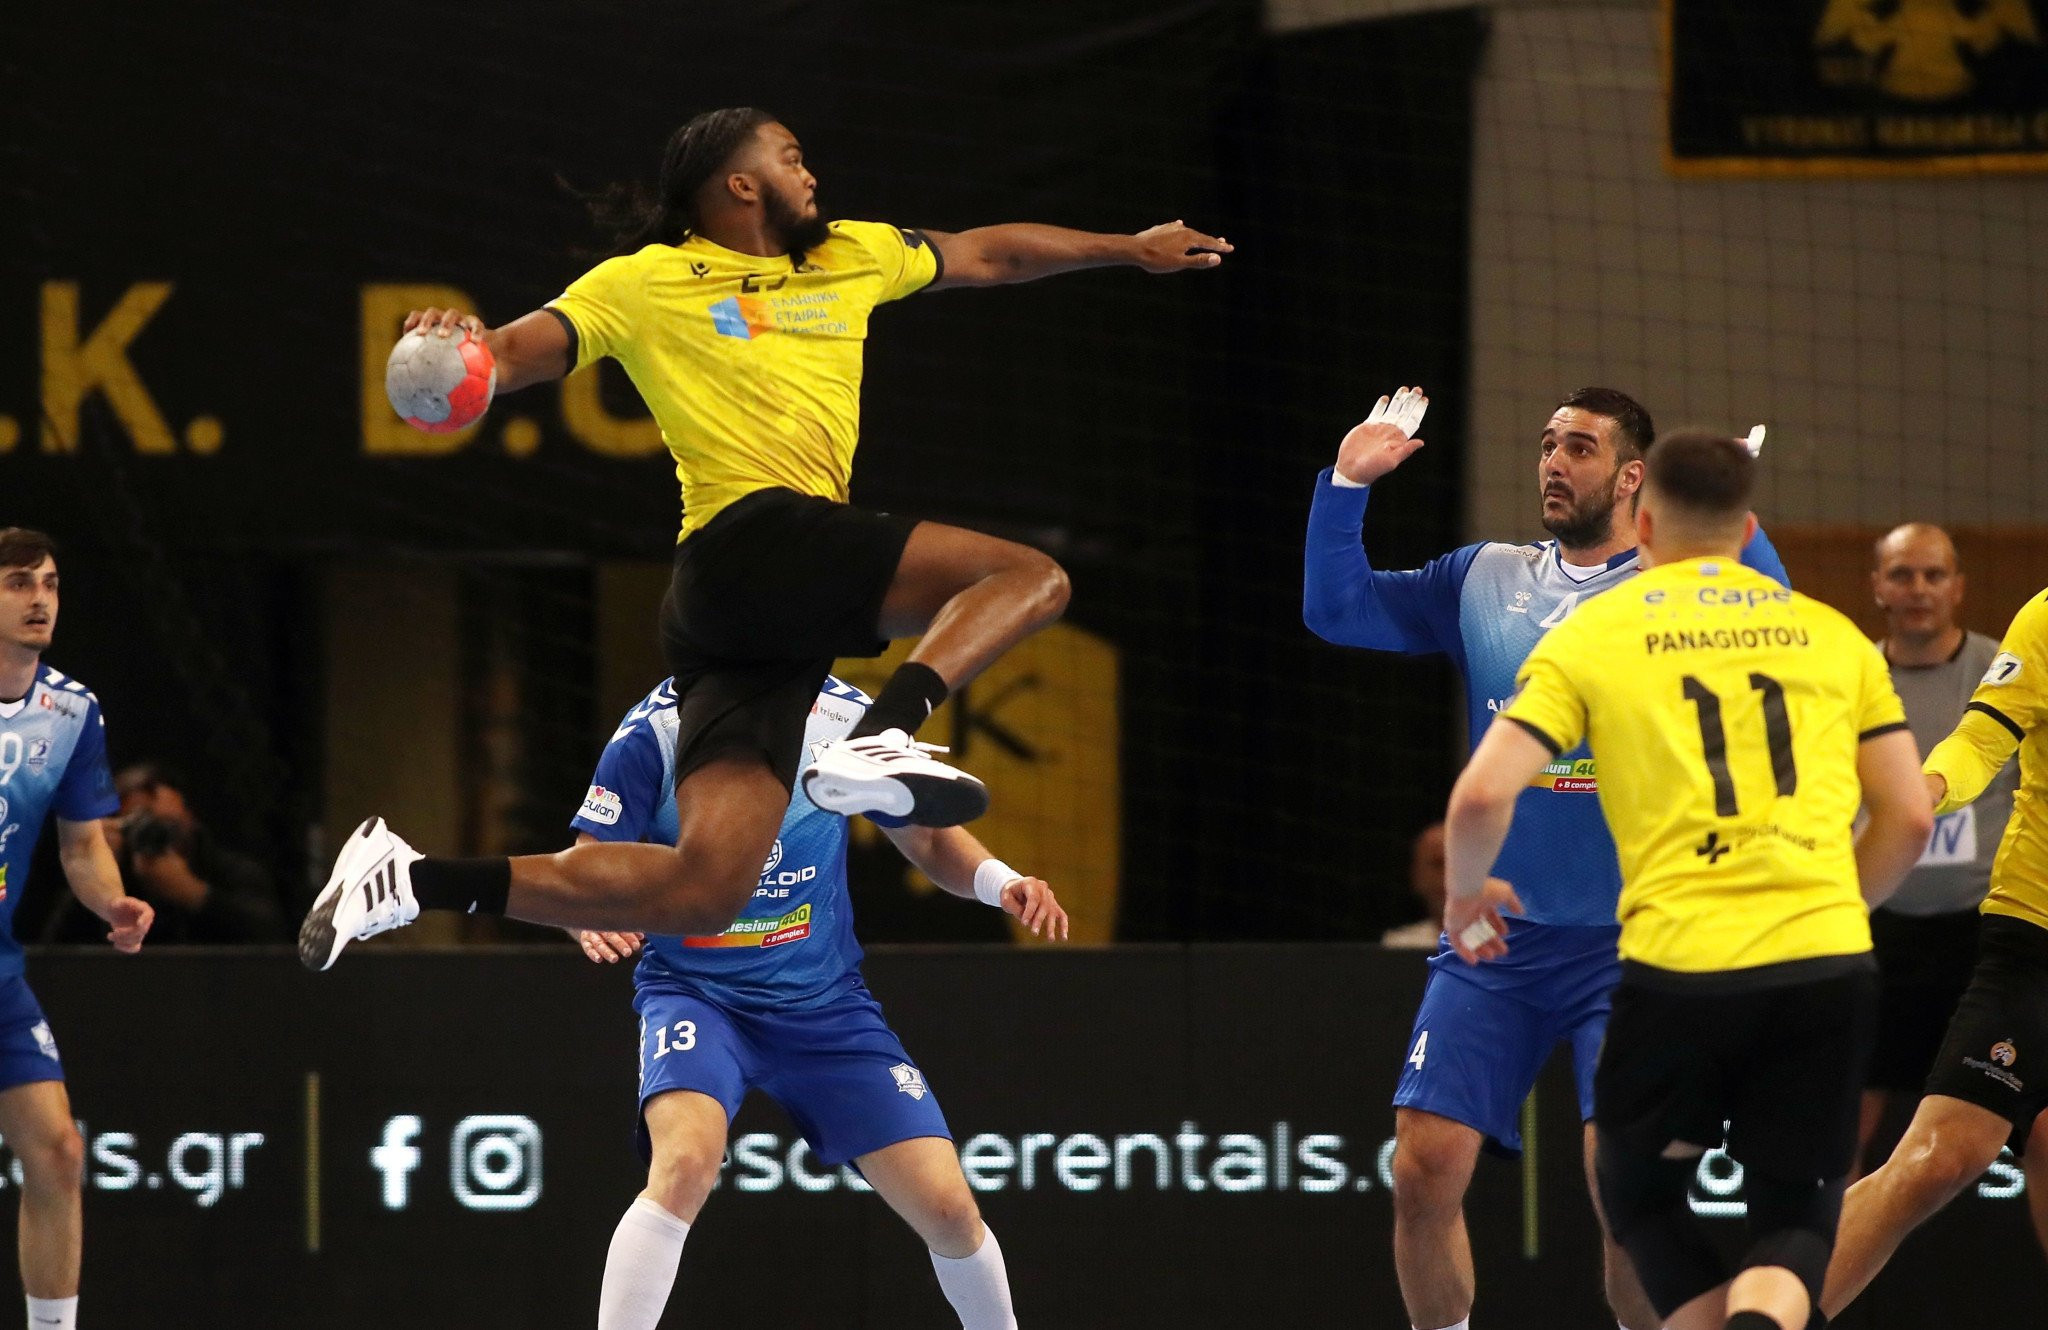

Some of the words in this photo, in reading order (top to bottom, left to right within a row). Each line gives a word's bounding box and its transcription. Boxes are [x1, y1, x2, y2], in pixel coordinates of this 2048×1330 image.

[1646, 626, 1809, 655] PANAGIOTOU
[820, 705, 850, 724] triglav
[1682, 672, 1797, 817] 11
[781, 908, 808, 926] 400
[777, 928, 805, 941] complex
[653, 1020, 697, 1060] 13
[1408, 1030, 1429, 1070] 4
